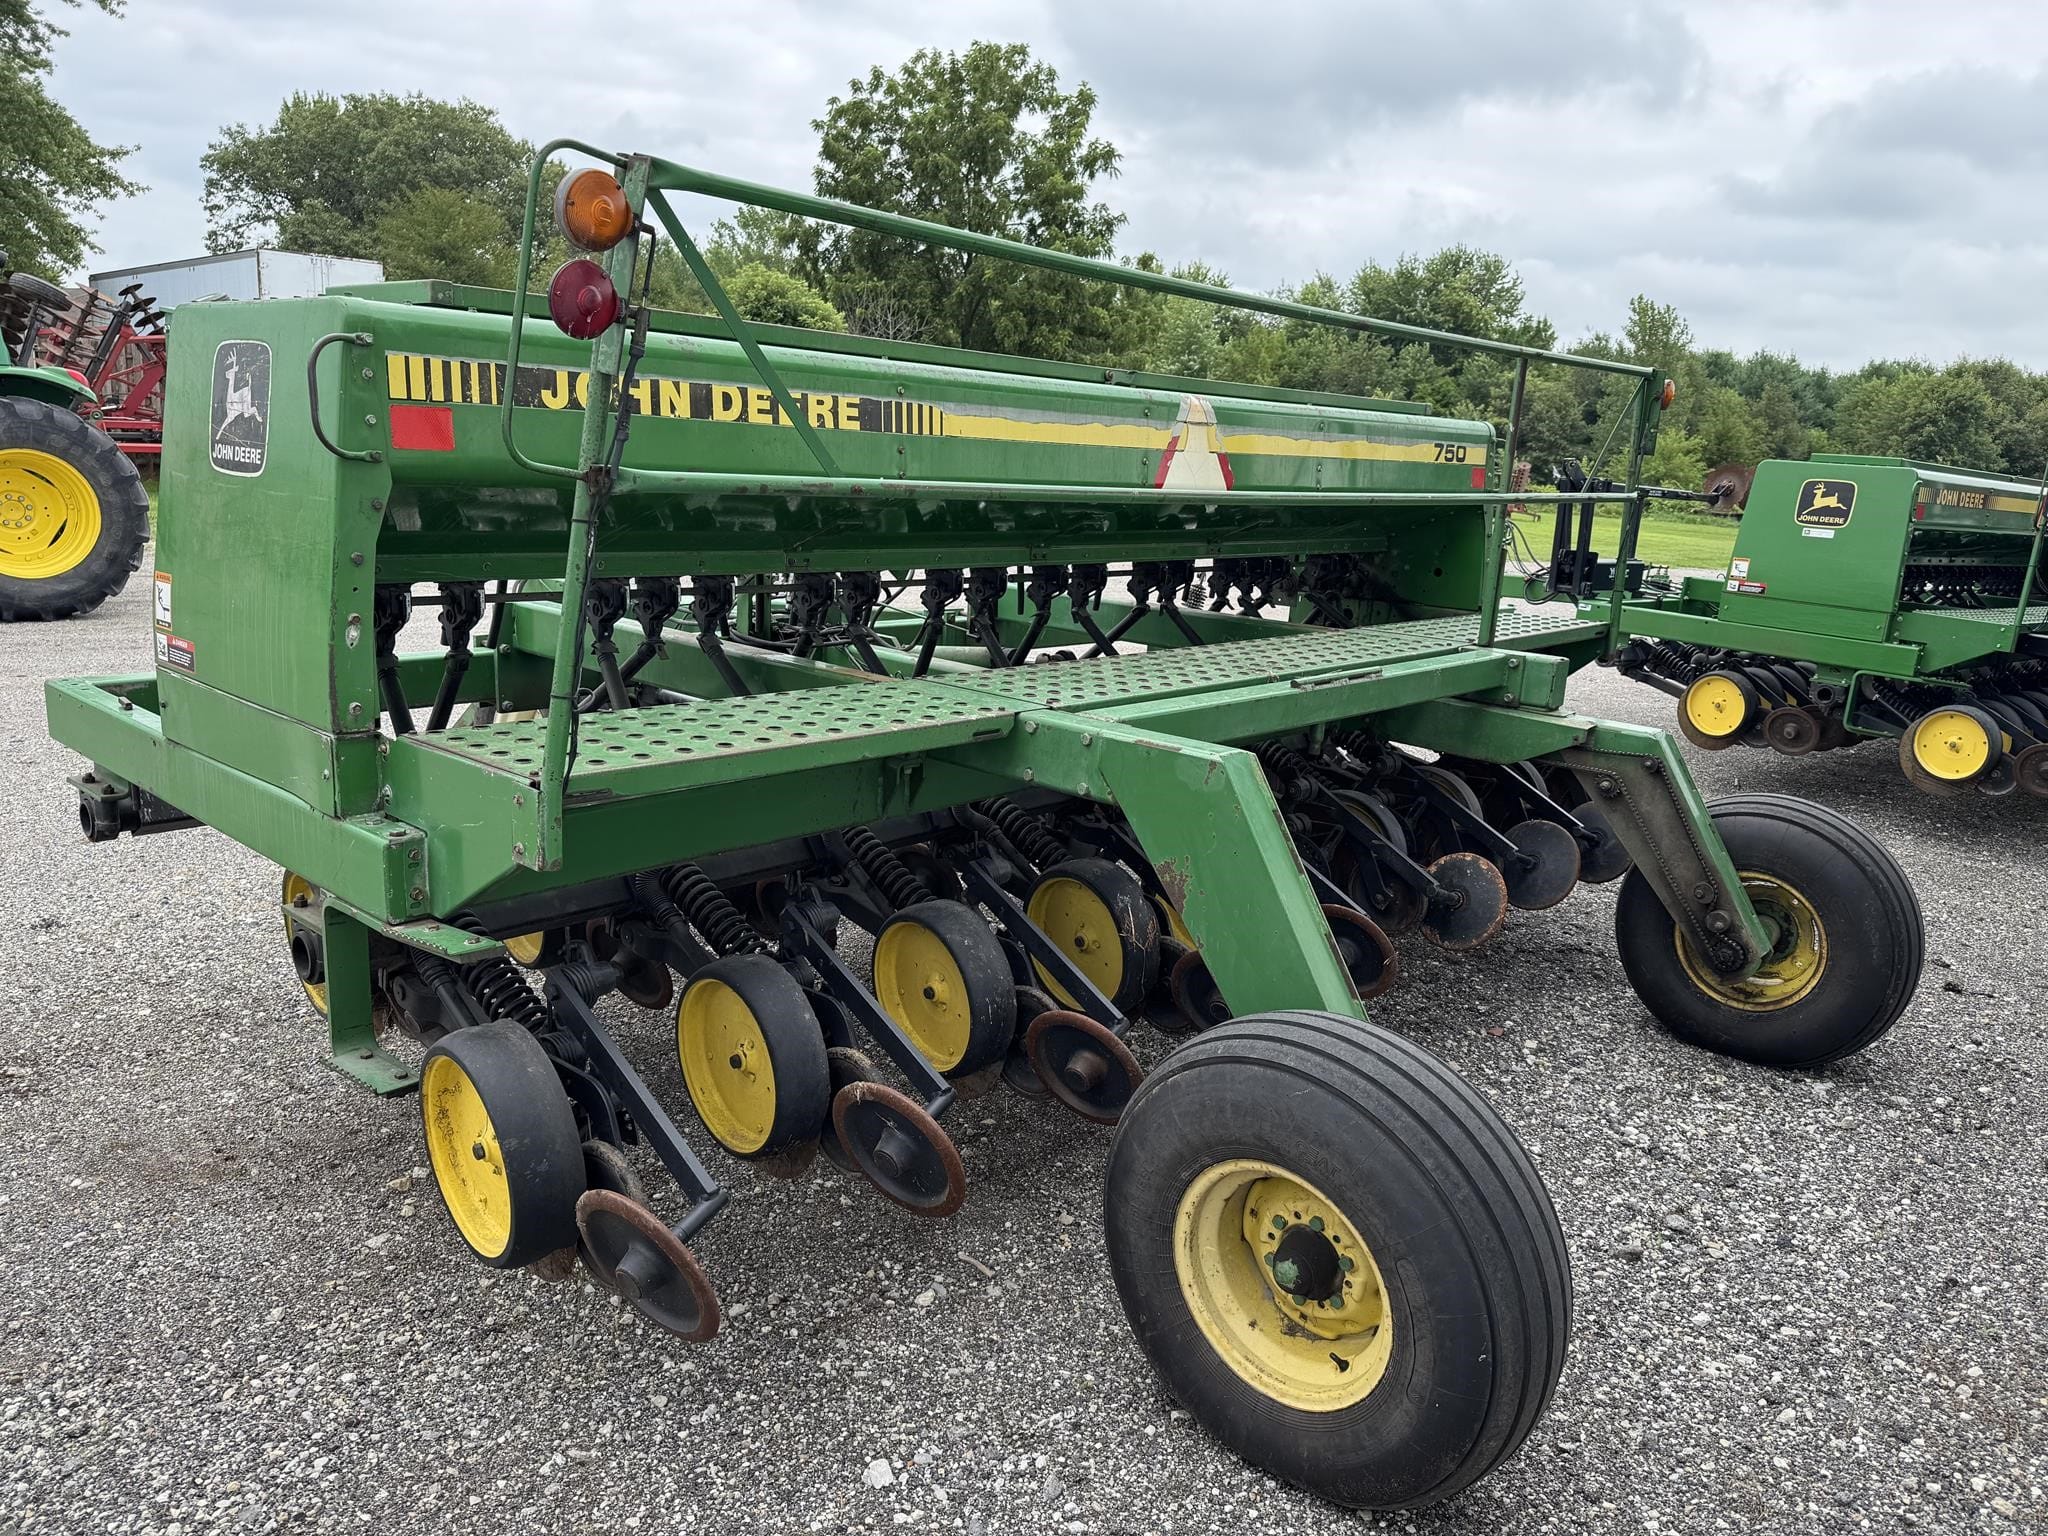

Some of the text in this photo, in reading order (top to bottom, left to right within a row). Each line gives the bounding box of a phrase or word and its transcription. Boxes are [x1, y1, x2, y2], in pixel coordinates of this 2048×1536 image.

[213, 443, 261, 464] JOHN DEERE
[1434, 443, 1467, 462] 750
[1936, 489, 1985, 509] JOHN DEERE
